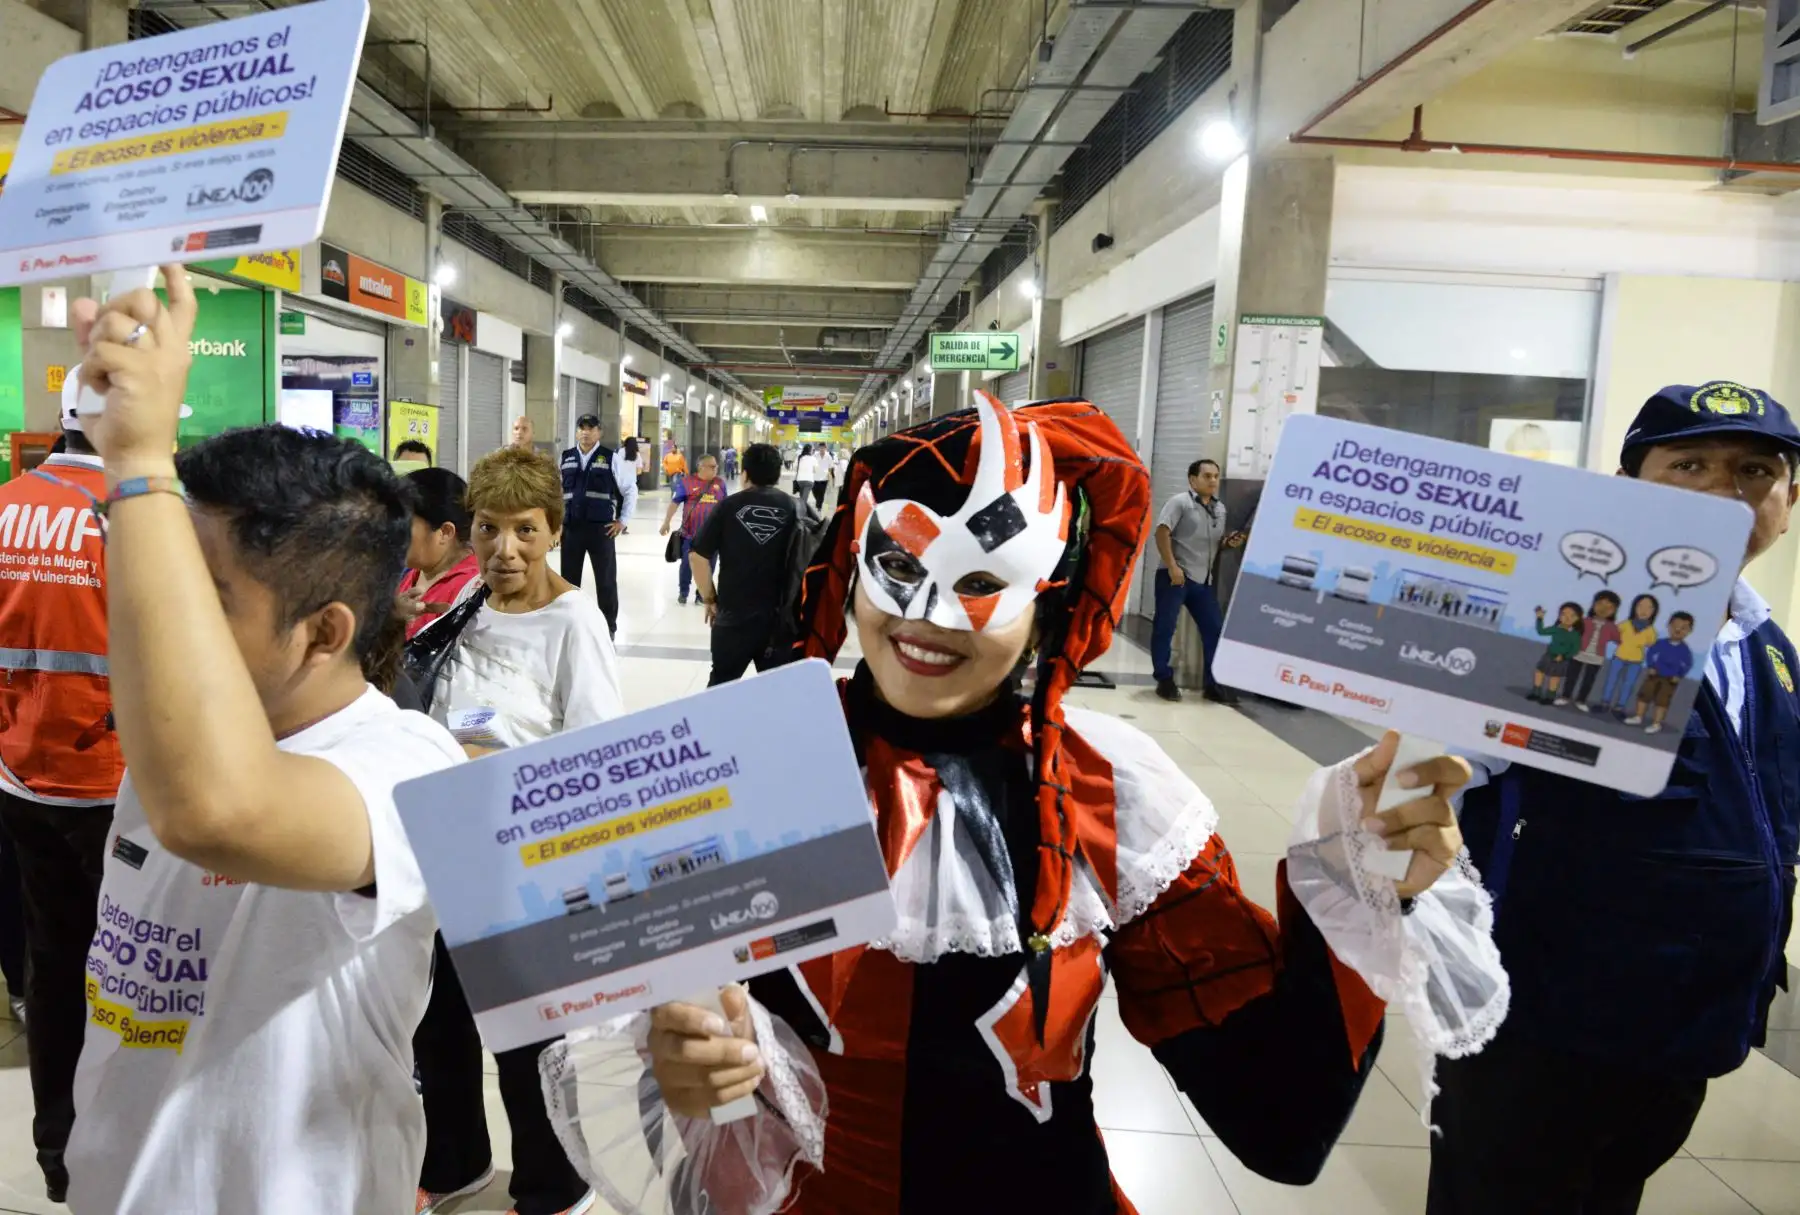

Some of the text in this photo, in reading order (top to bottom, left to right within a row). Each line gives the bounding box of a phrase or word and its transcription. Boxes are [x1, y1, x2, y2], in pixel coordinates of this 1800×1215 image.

[74, 52, 295, 114] ACOSO SEXUAL
[96, 25, 291, 88] ¡Detengamos el
[44, 75, 317, 146] en espacios públicos!
[68, 150, 87, 169] El
[90, 144, 147, 165] acoso
[151, 138, 174, 154] es
[179, 121, 265, 149] violencia
[187, 338, 246, 357] erbank
[934, 353, 986, 363] EMERGENCIA
[939, 340, 981, 350] SALIDA DE
[1313, 460, 1524, 522] ACOSO SEXUAL
[1332, 440, 1522, 494] ¡Detengamos el
[1285, 483, 1543, 551] en espacios públicos!
[1312, 514, 1331, 530] El
[1332, 520, 1387, 543] acoso
[1390, 535, 1413, 550] es
[1416, 540, 1496, 569] violencia
[0, 568, 102, 588] ciones Vulnerables
[28, 554, 39, 565] de
[41, 554, 52, 566] la
[53, 555, 90, 571] Mujer
[91, 562, 97, 573] y
[511, 740, 711, 815] ACOSO SEXUAL
[512, 717, 691, 791] ¡Detengamos el
[496, 755, 740, 846] en espacios públicos!
[539, 841, 556, 860] El
[560, 828, 611, 852] acoso
[616, 822, 635, 836] es
[639, 796, 712, 829] violencia
[176, 928, 201, 952] el
